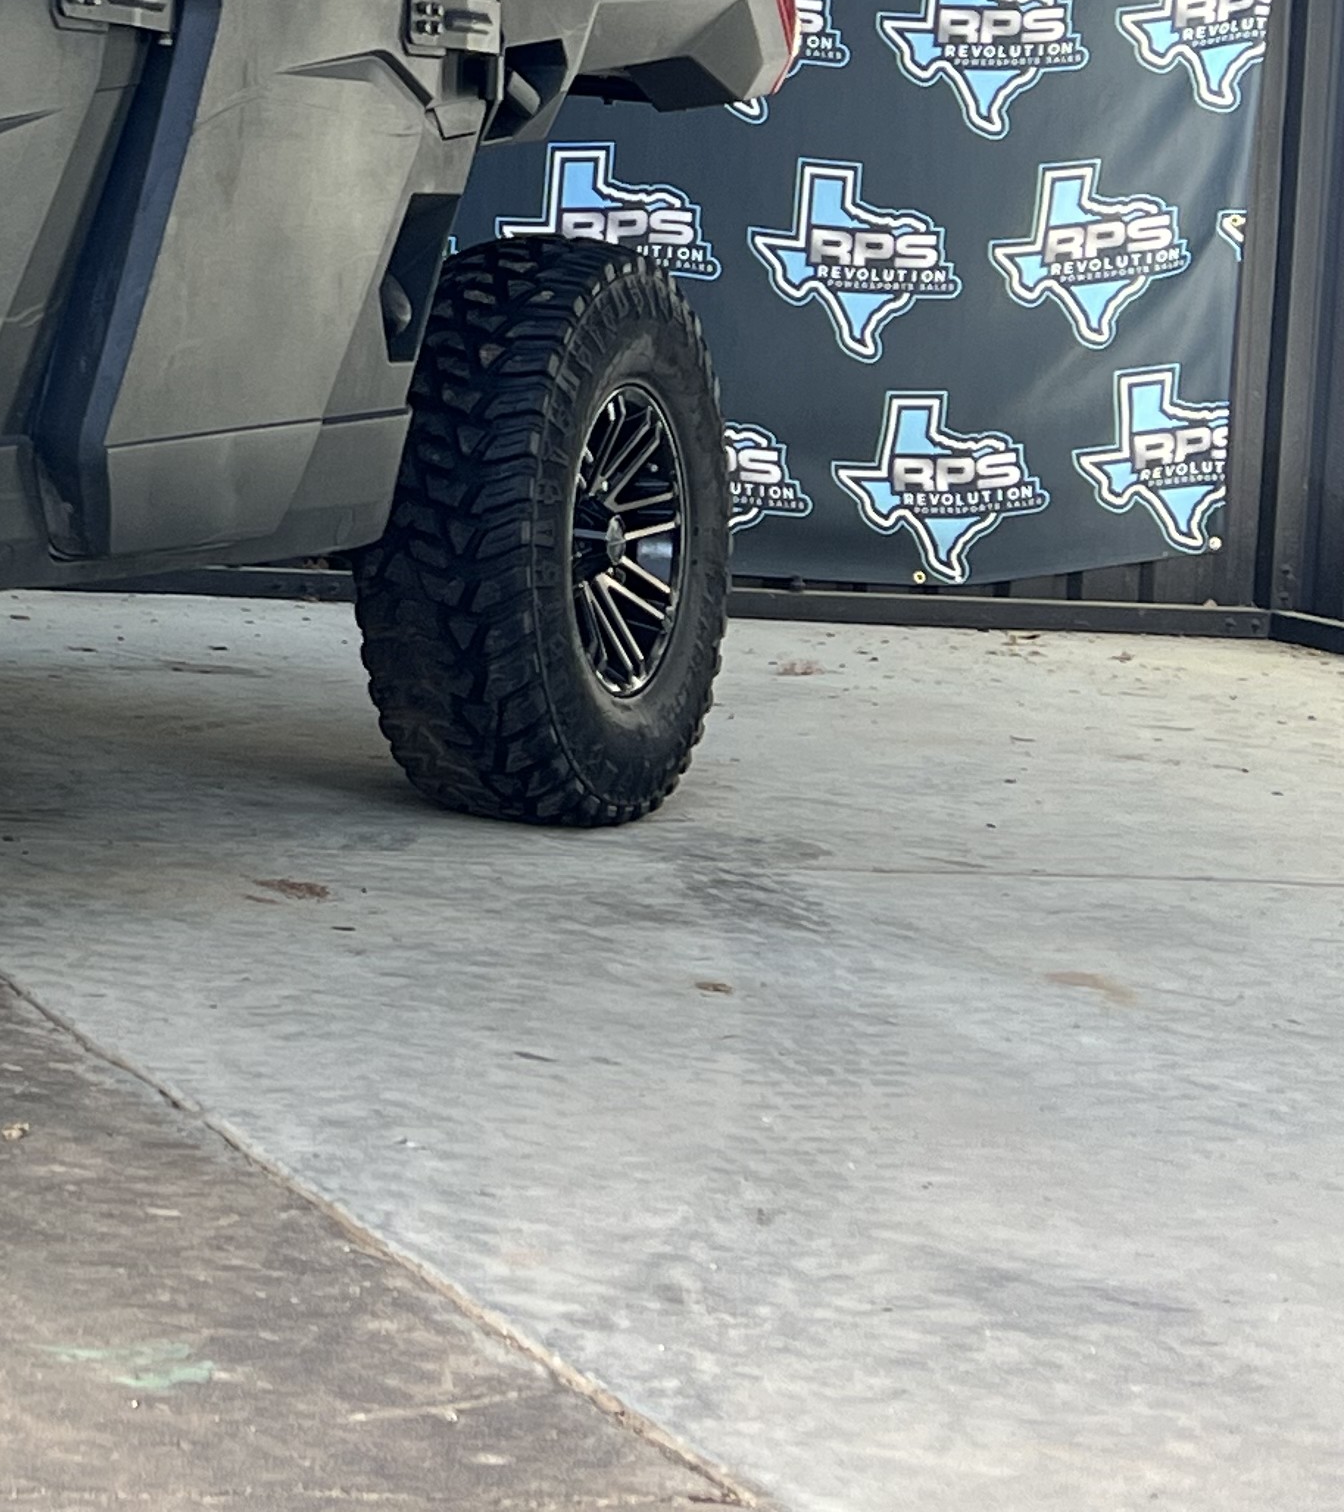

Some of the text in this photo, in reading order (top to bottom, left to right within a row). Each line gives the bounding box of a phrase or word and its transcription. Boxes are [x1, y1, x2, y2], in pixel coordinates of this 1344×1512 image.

[937, 7, 1065, 44] RPS
[1182, 17, 1268, 40] REVOLUT
[945, 42, 1073, 58] REVOLUTION
[561, 209, 694, 245] RPS
[1044, 214, 1173, 262] RPS
[809, 229, 937, 267] RPS
[817, 265, 946, 281] REVOLUTION
[1051, 249, 1180, 276] REVOLUTION
[892, 451, 1021, 492] RPS
[1140, 461, 1225, 482] REVOLUT
[903, 485, 1032, 506] REVOLUTION
